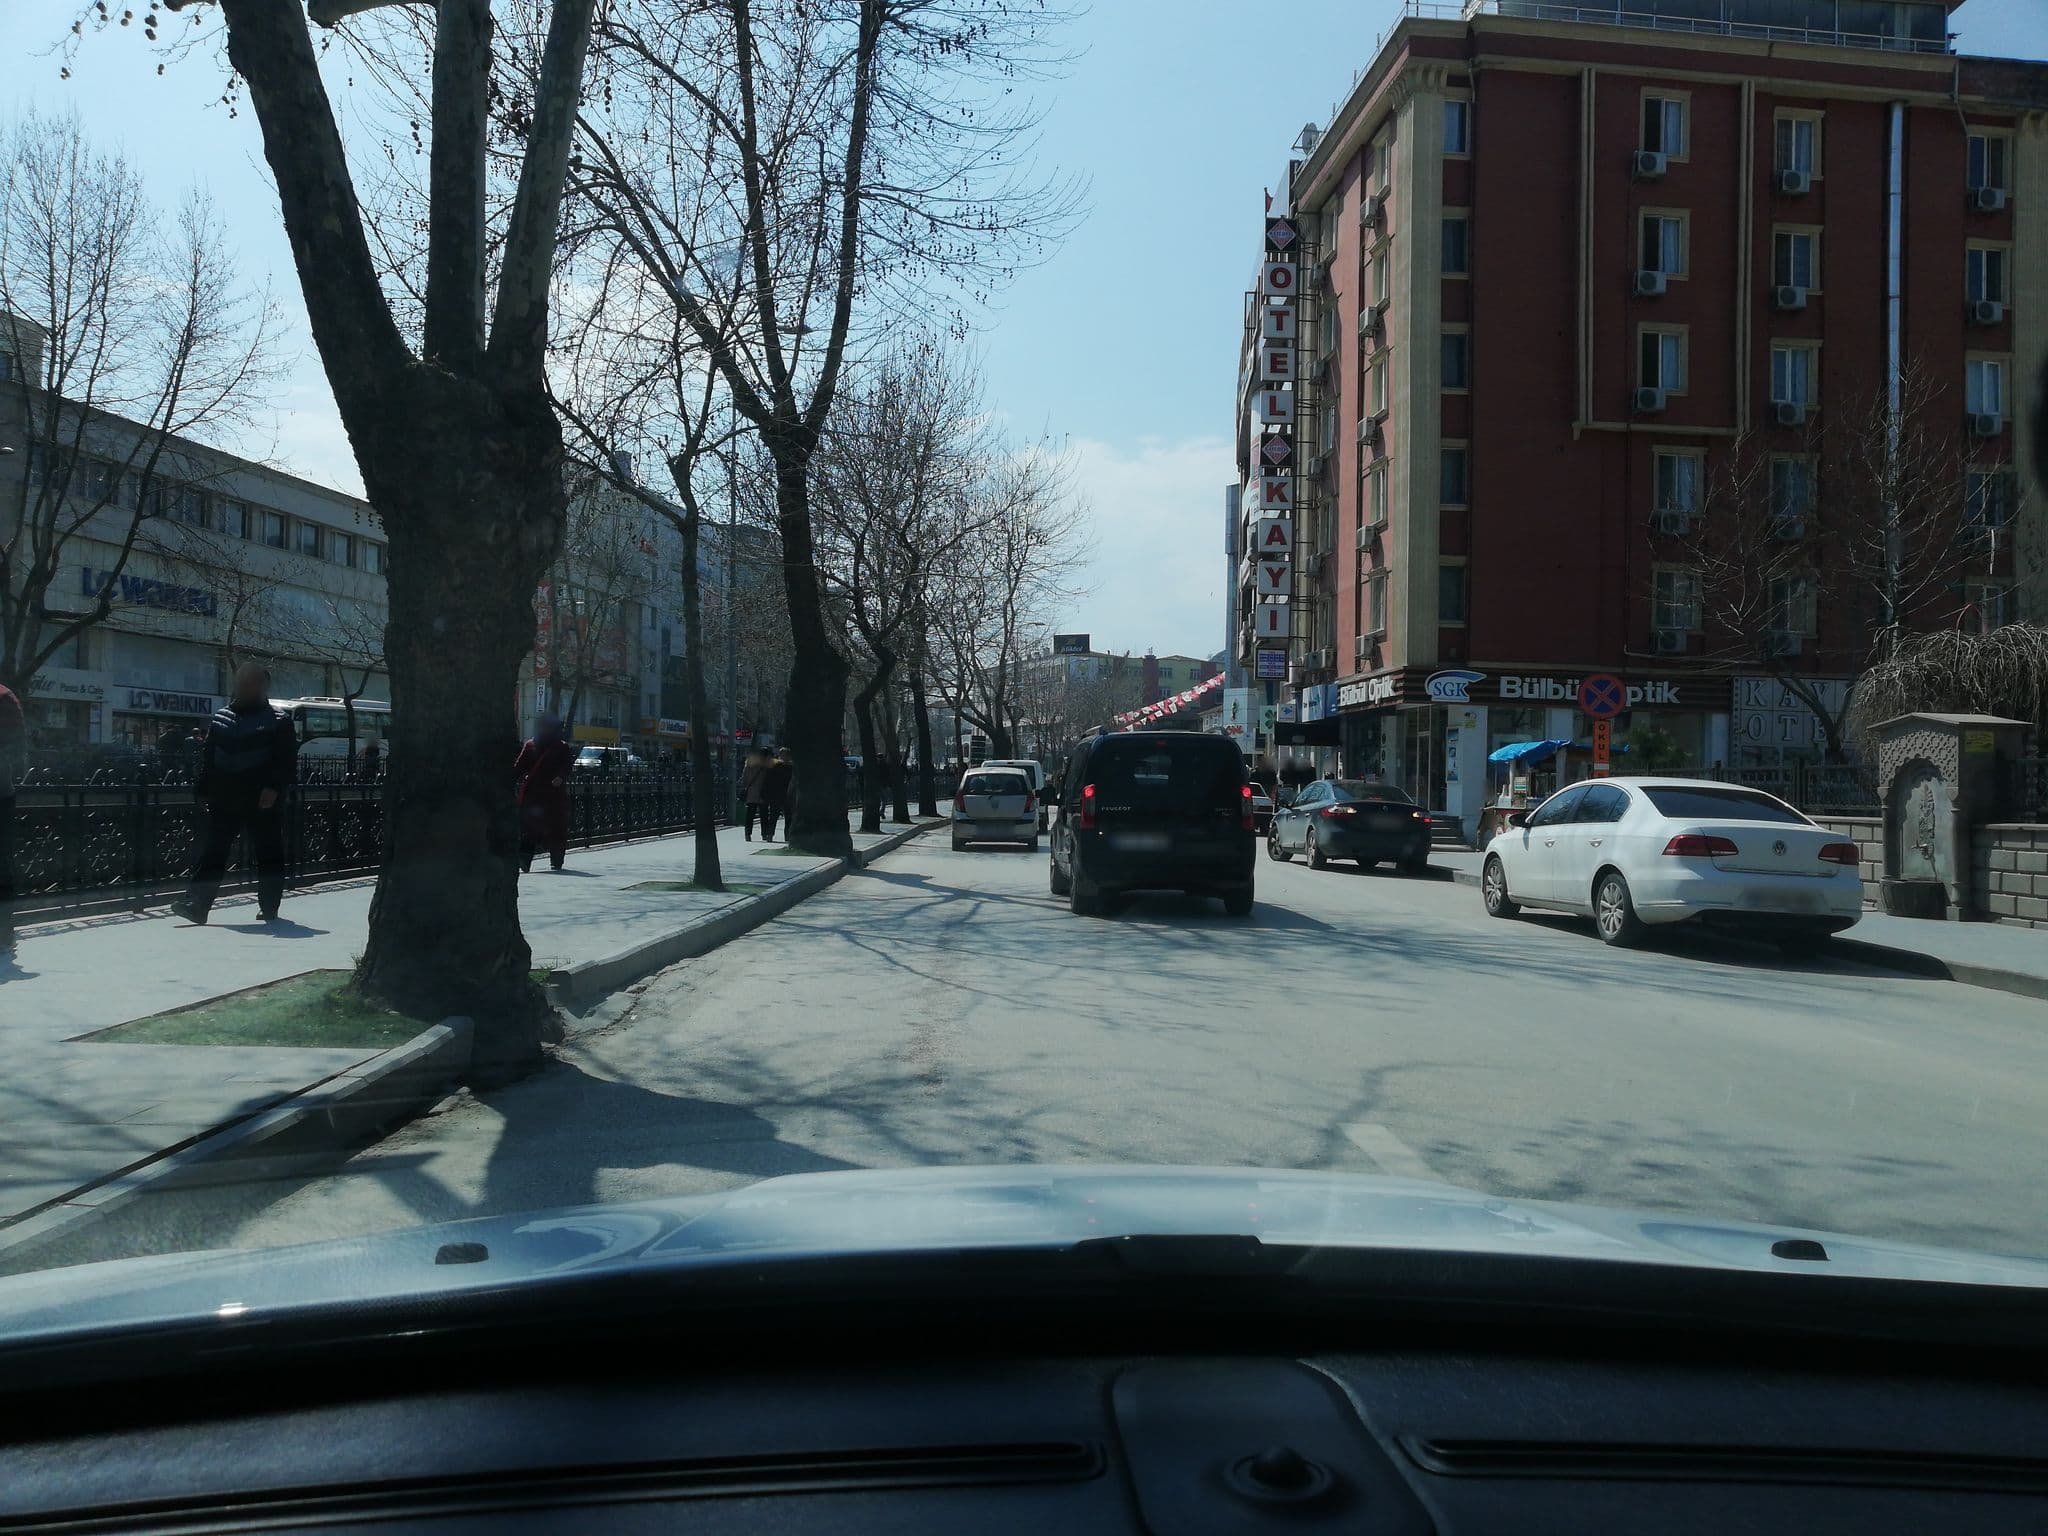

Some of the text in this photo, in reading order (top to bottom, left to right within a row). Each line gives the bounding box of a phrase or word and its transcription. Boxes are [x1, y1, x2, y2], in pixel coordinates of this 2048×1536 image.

[1269, 267, 1291, 417] OTEL
[1264, 482, 1289, 631] KAYI
[130, 689, 151, 709] LC
[1369, 675, 1396, 704] Optik
[1433, 681, 1467, 698] SGK
[1499, 676, 1681, 706] Bülbü ptik
